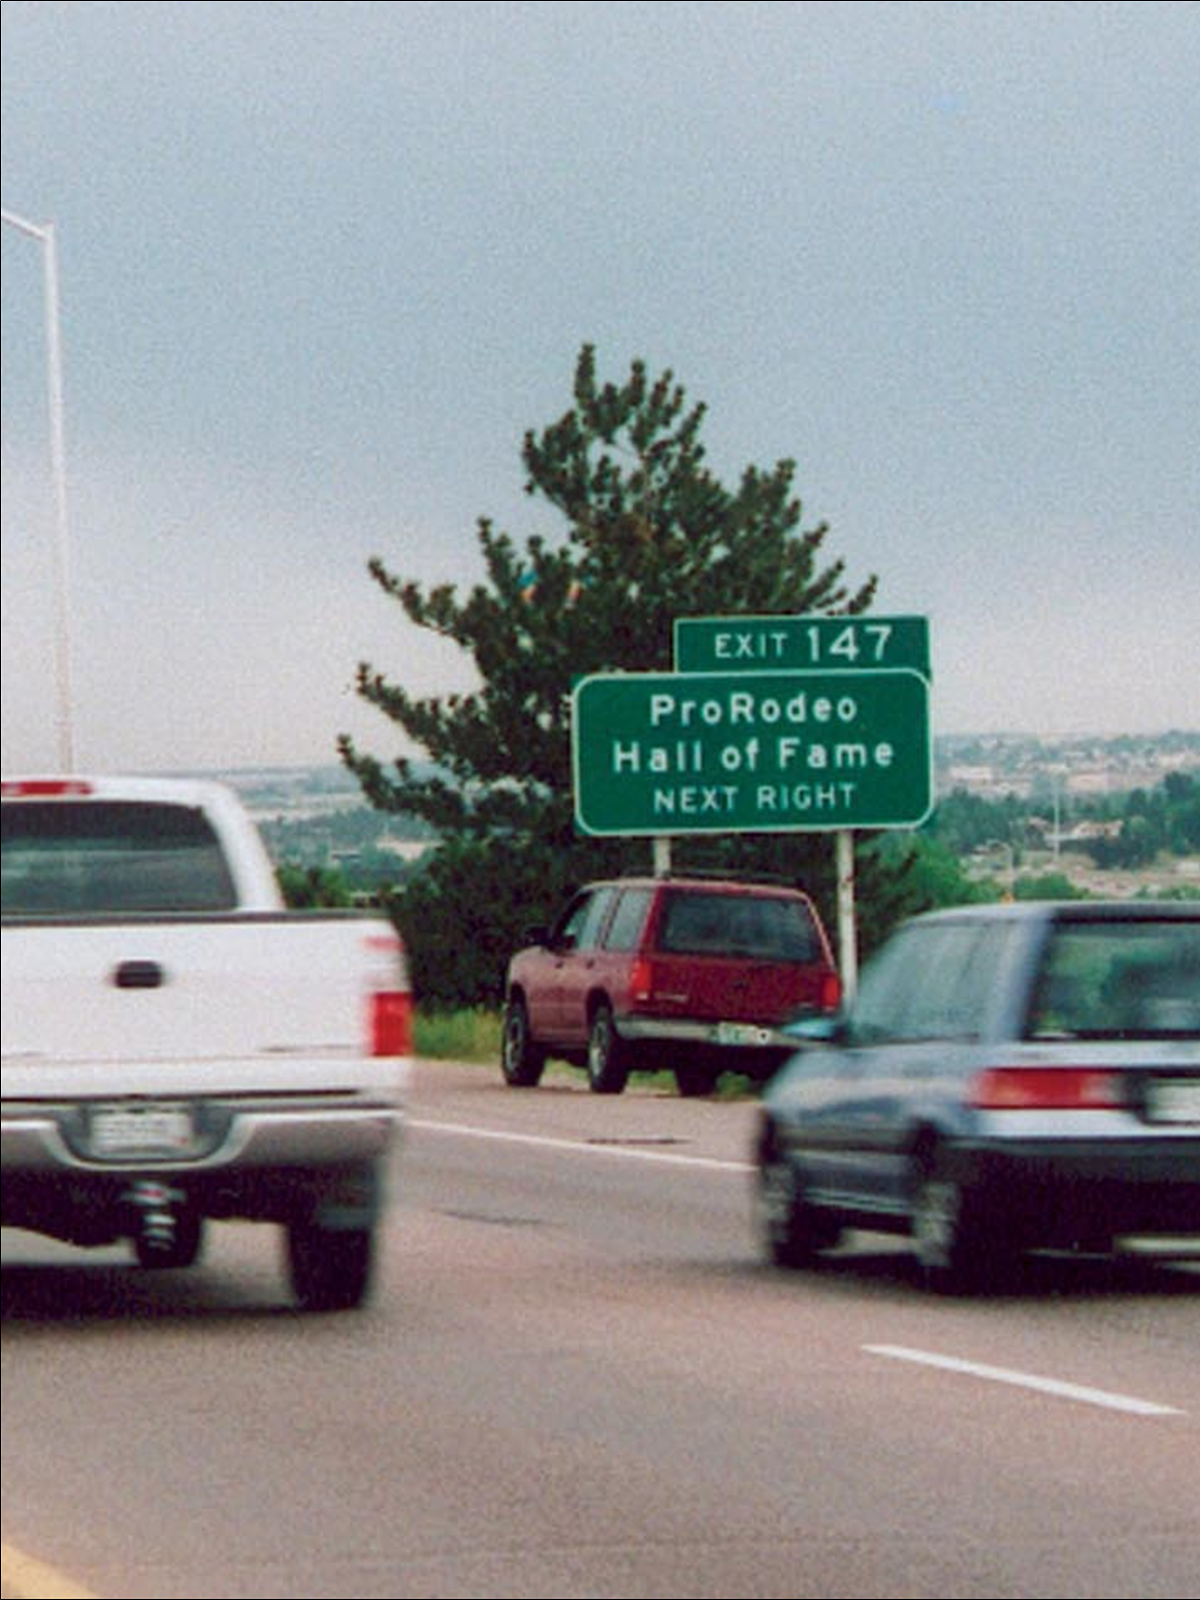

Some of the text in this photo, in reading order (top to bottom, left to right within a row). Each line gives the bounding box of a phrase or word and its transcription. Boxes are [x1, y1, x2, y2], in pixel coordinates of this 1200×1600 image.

[714, 625, 893, 661] EXIT 147
[650, 692, 857, 726] ProRodeo
[613, 737, 895, 772] Hall of Fame
[653, 782, 857, 814] NEXT RIGHT
